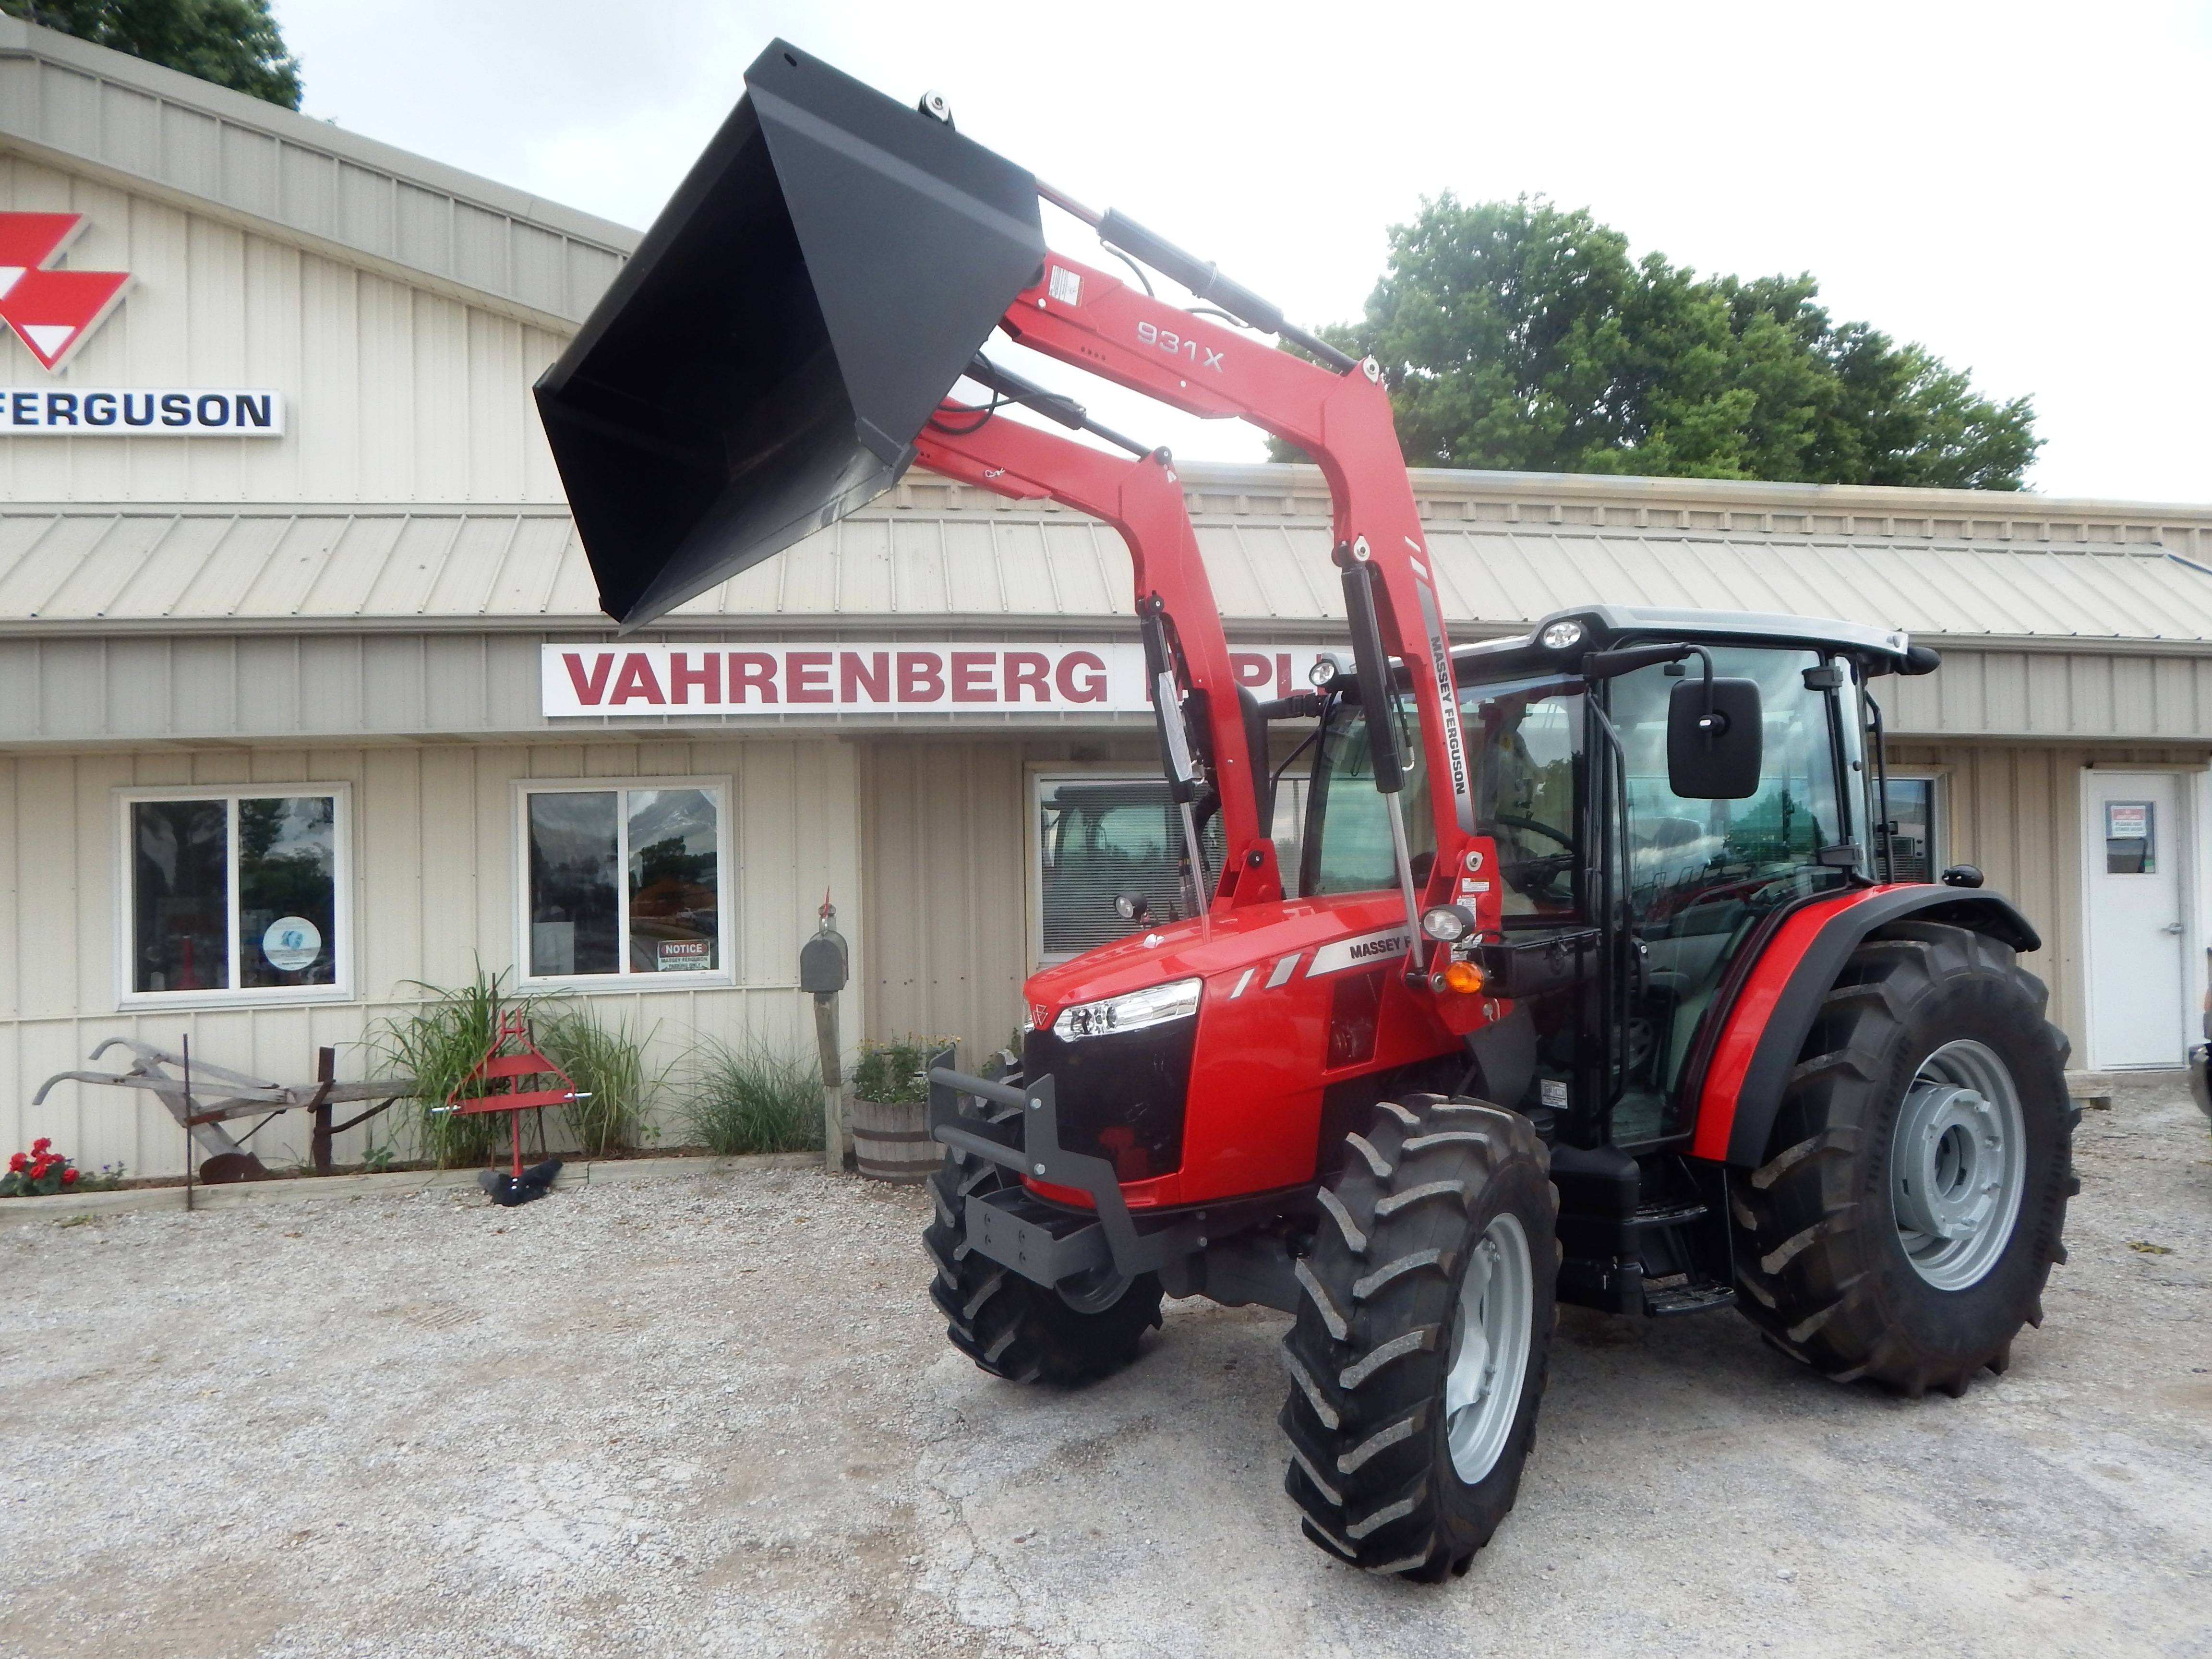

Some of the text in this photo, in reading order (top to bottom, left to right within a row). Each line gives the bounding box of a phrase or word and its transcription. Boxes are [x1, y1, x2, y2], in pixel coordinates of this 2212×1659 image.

[1137, 321, 1224, 373] 931X
[0, 392, 271, 427] ERGUSON
[562, 652, 1106, 705] VAHRENBERG
[1431, 636, 1466, 795] MASSEY FERGUSON
[666, 944, 702, 954] NOTICE
[1349, 937, 1400, 959] MASSEY
